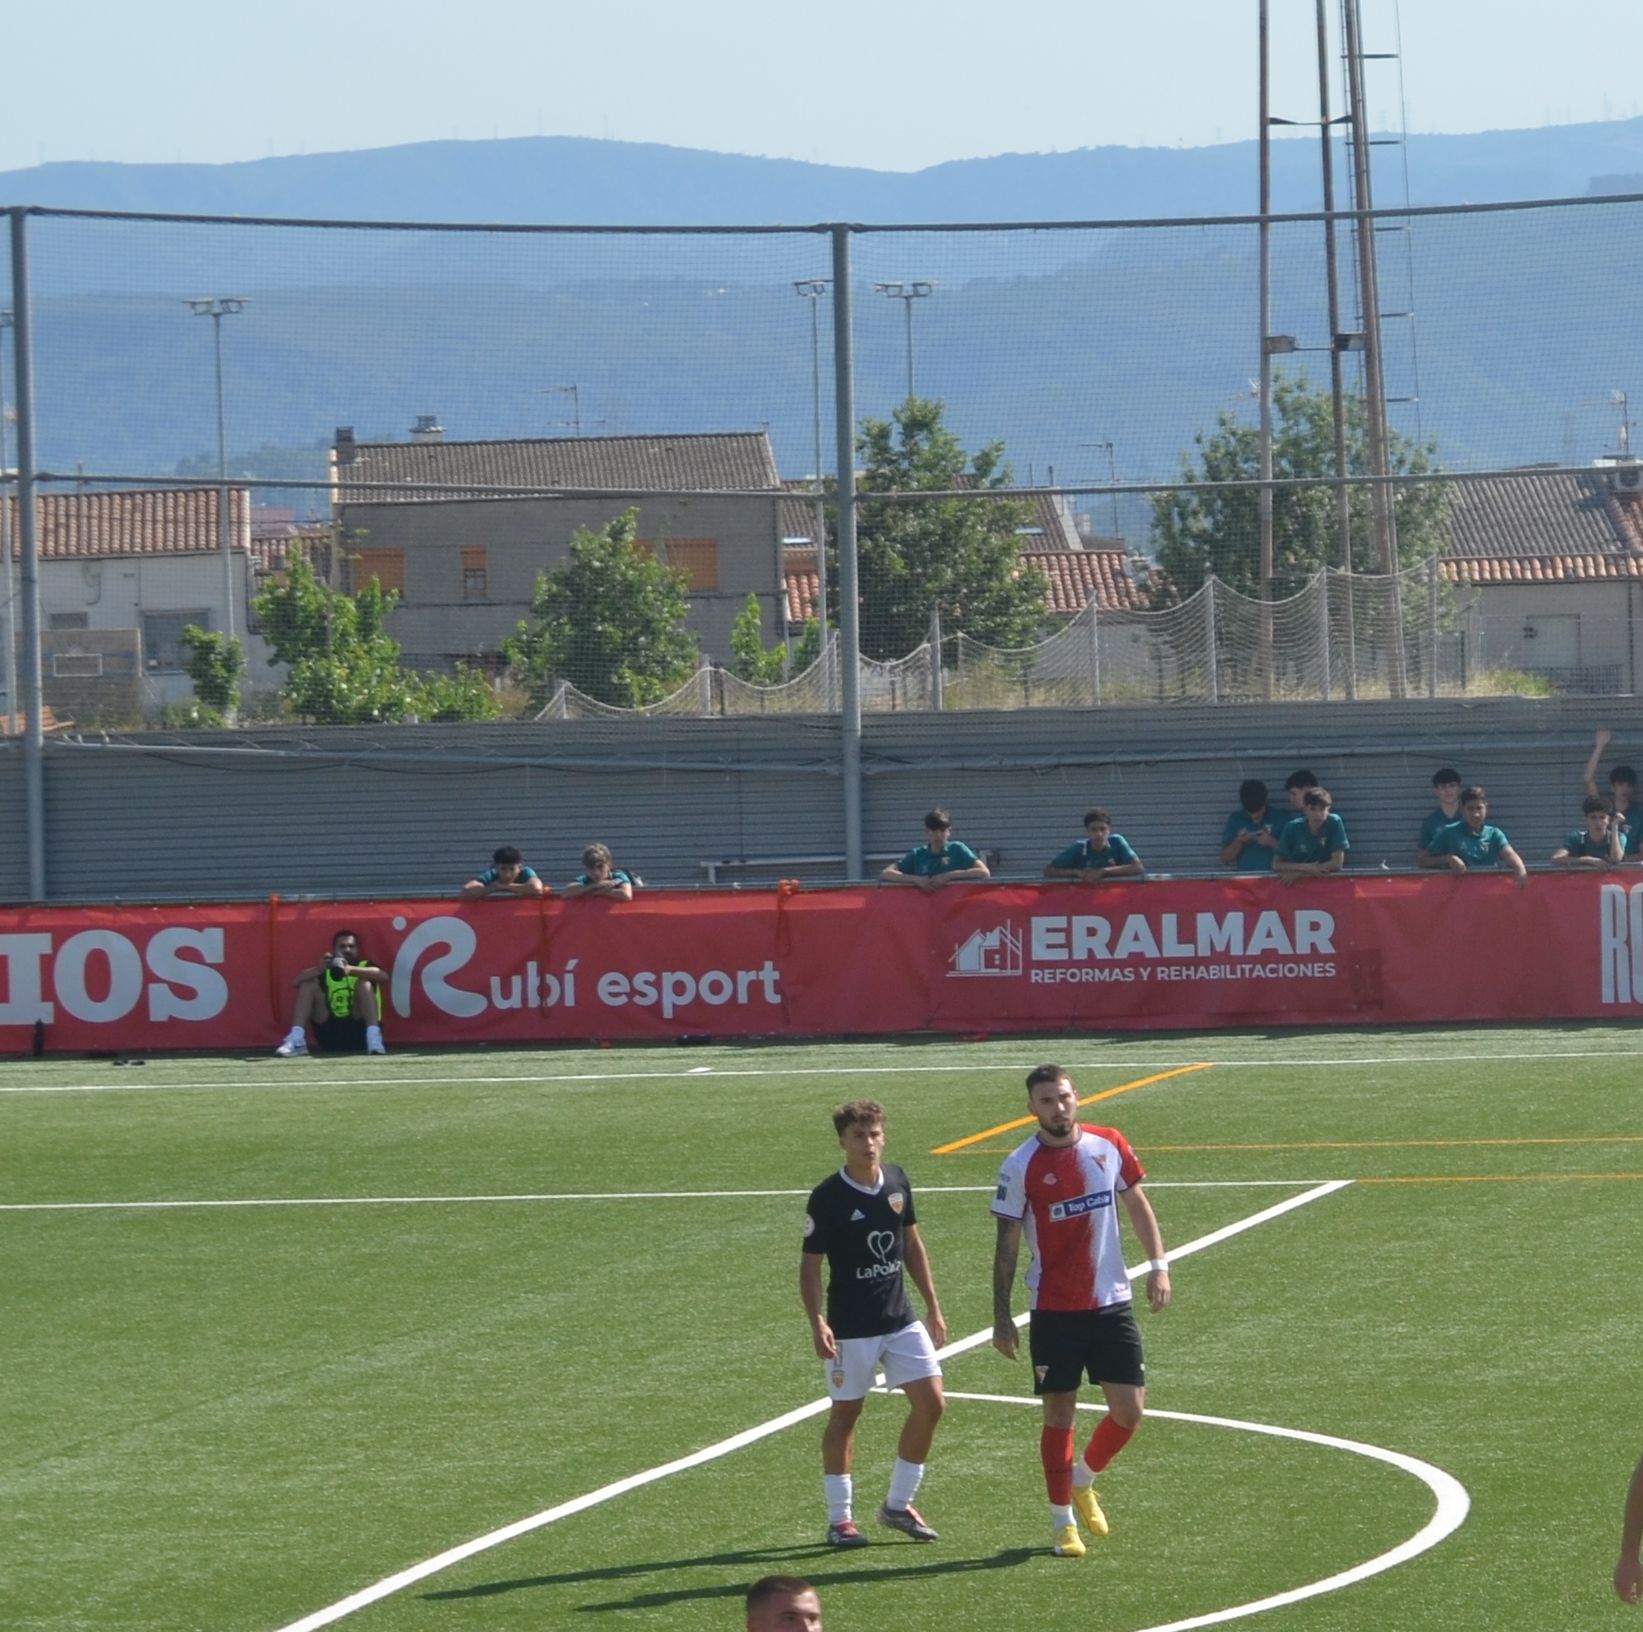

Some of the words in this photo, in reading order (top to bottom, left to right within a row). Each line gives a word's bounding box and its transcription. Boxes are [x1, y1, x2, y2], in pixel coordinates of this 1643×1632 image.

[1030, 909, 1336, 962] ERALMAR
[597, 960, 780, 1019] esport
[1030, 965, 1135, 984] REFORMAS
[1137, 964, 1153, 981] Y
[1156, 961, 1336, 981] REHABILITACIONES
[1068, 1201, 1086, 1213] Top
